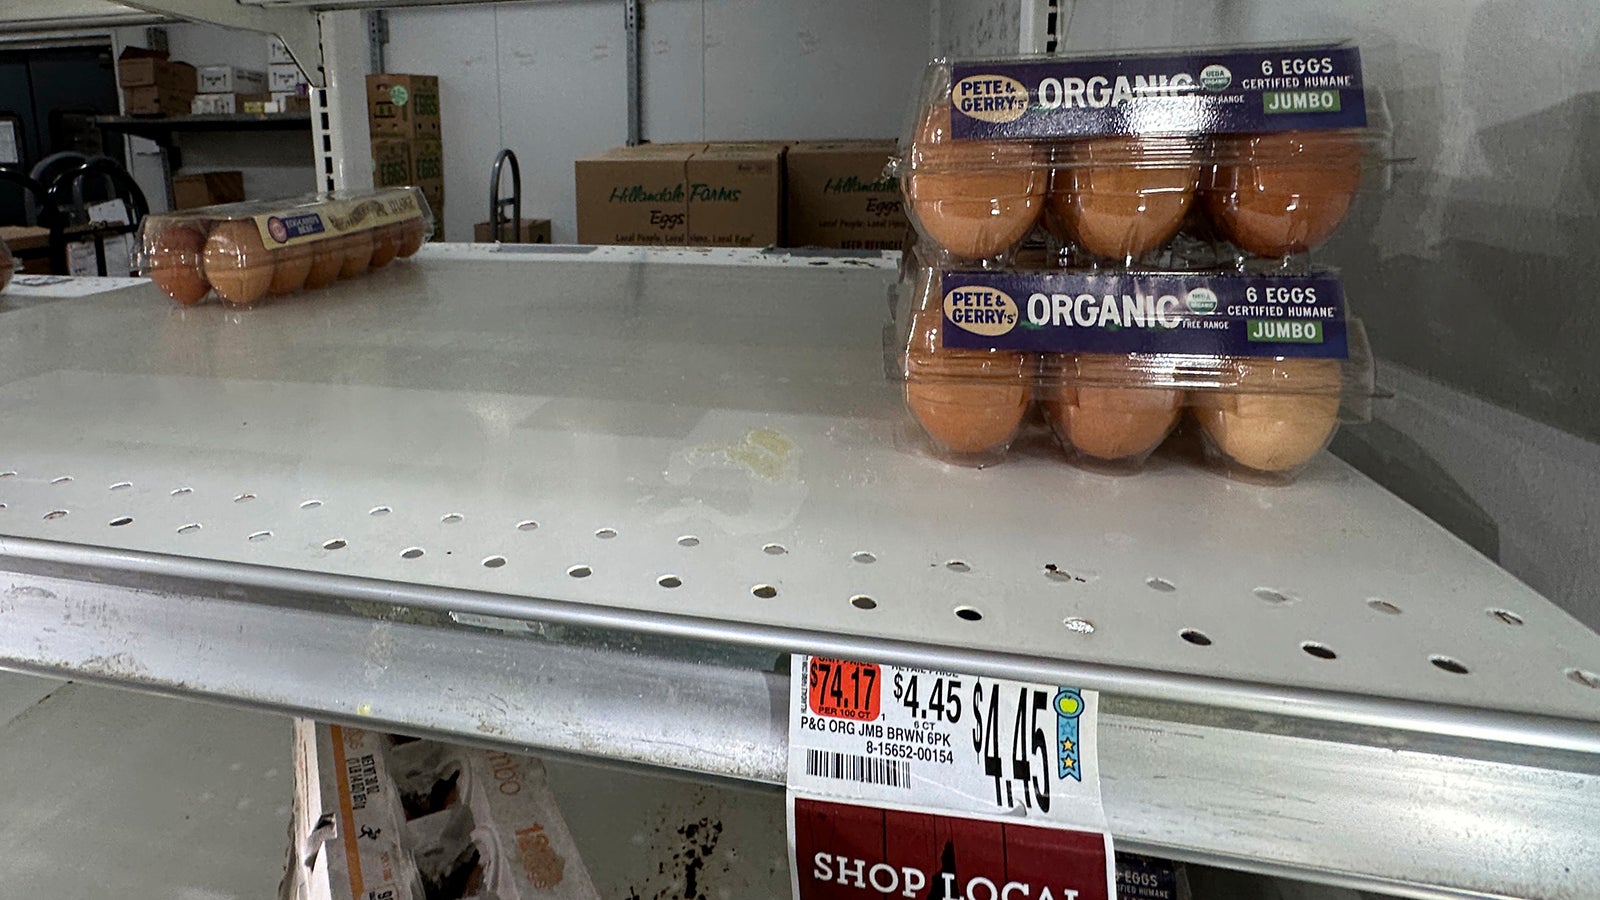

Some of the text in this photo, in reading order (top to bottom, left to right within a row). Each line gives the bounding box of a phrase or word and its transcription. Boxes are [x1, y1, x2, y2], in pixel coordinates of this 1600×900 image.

[1261, 57, 1333, 75] 6 EGGS
[961, 80, 1016, 97] PETE &
[1038, 73, 1194, 109] ORGANIC
[1242, 75, 1351, 90] CERTIFIED HUMANE
[1269, 91, 1334, 110] JUMBO
[690, 183, 742, 204] Farms
[866, 198, 901, 216] Eggs
[650, 210, 685, 230] Eggs
[952, 291, 1006, 307] PETE &
[1246, 286, 1316, 304] 6 EGGS
[1026, 292, 1182, 329] ORGANIC
[1227, 305, 1334, 319] CERTIFIED HUMANE
[1203, 320, 1230, 331] RANGE
[1253, 322, 1317, 339] JUMBO
[810, 662, 877, 711] $74.17
[893, 672, 962, 724] $4.45
[818, 706, 871, 720] PER 100 CT
[801, 717, 951, 747] P&G ORG JMB BRWN 6PK
[914, 721, 936, 731] 6 CT
[866, 741, 954, 764] 8-15652-00154
[972, 675, 1051, 813] $4.45
[814, 852, 925, 898] SHOP
[1125, 870, 1158, 887] EGGS
